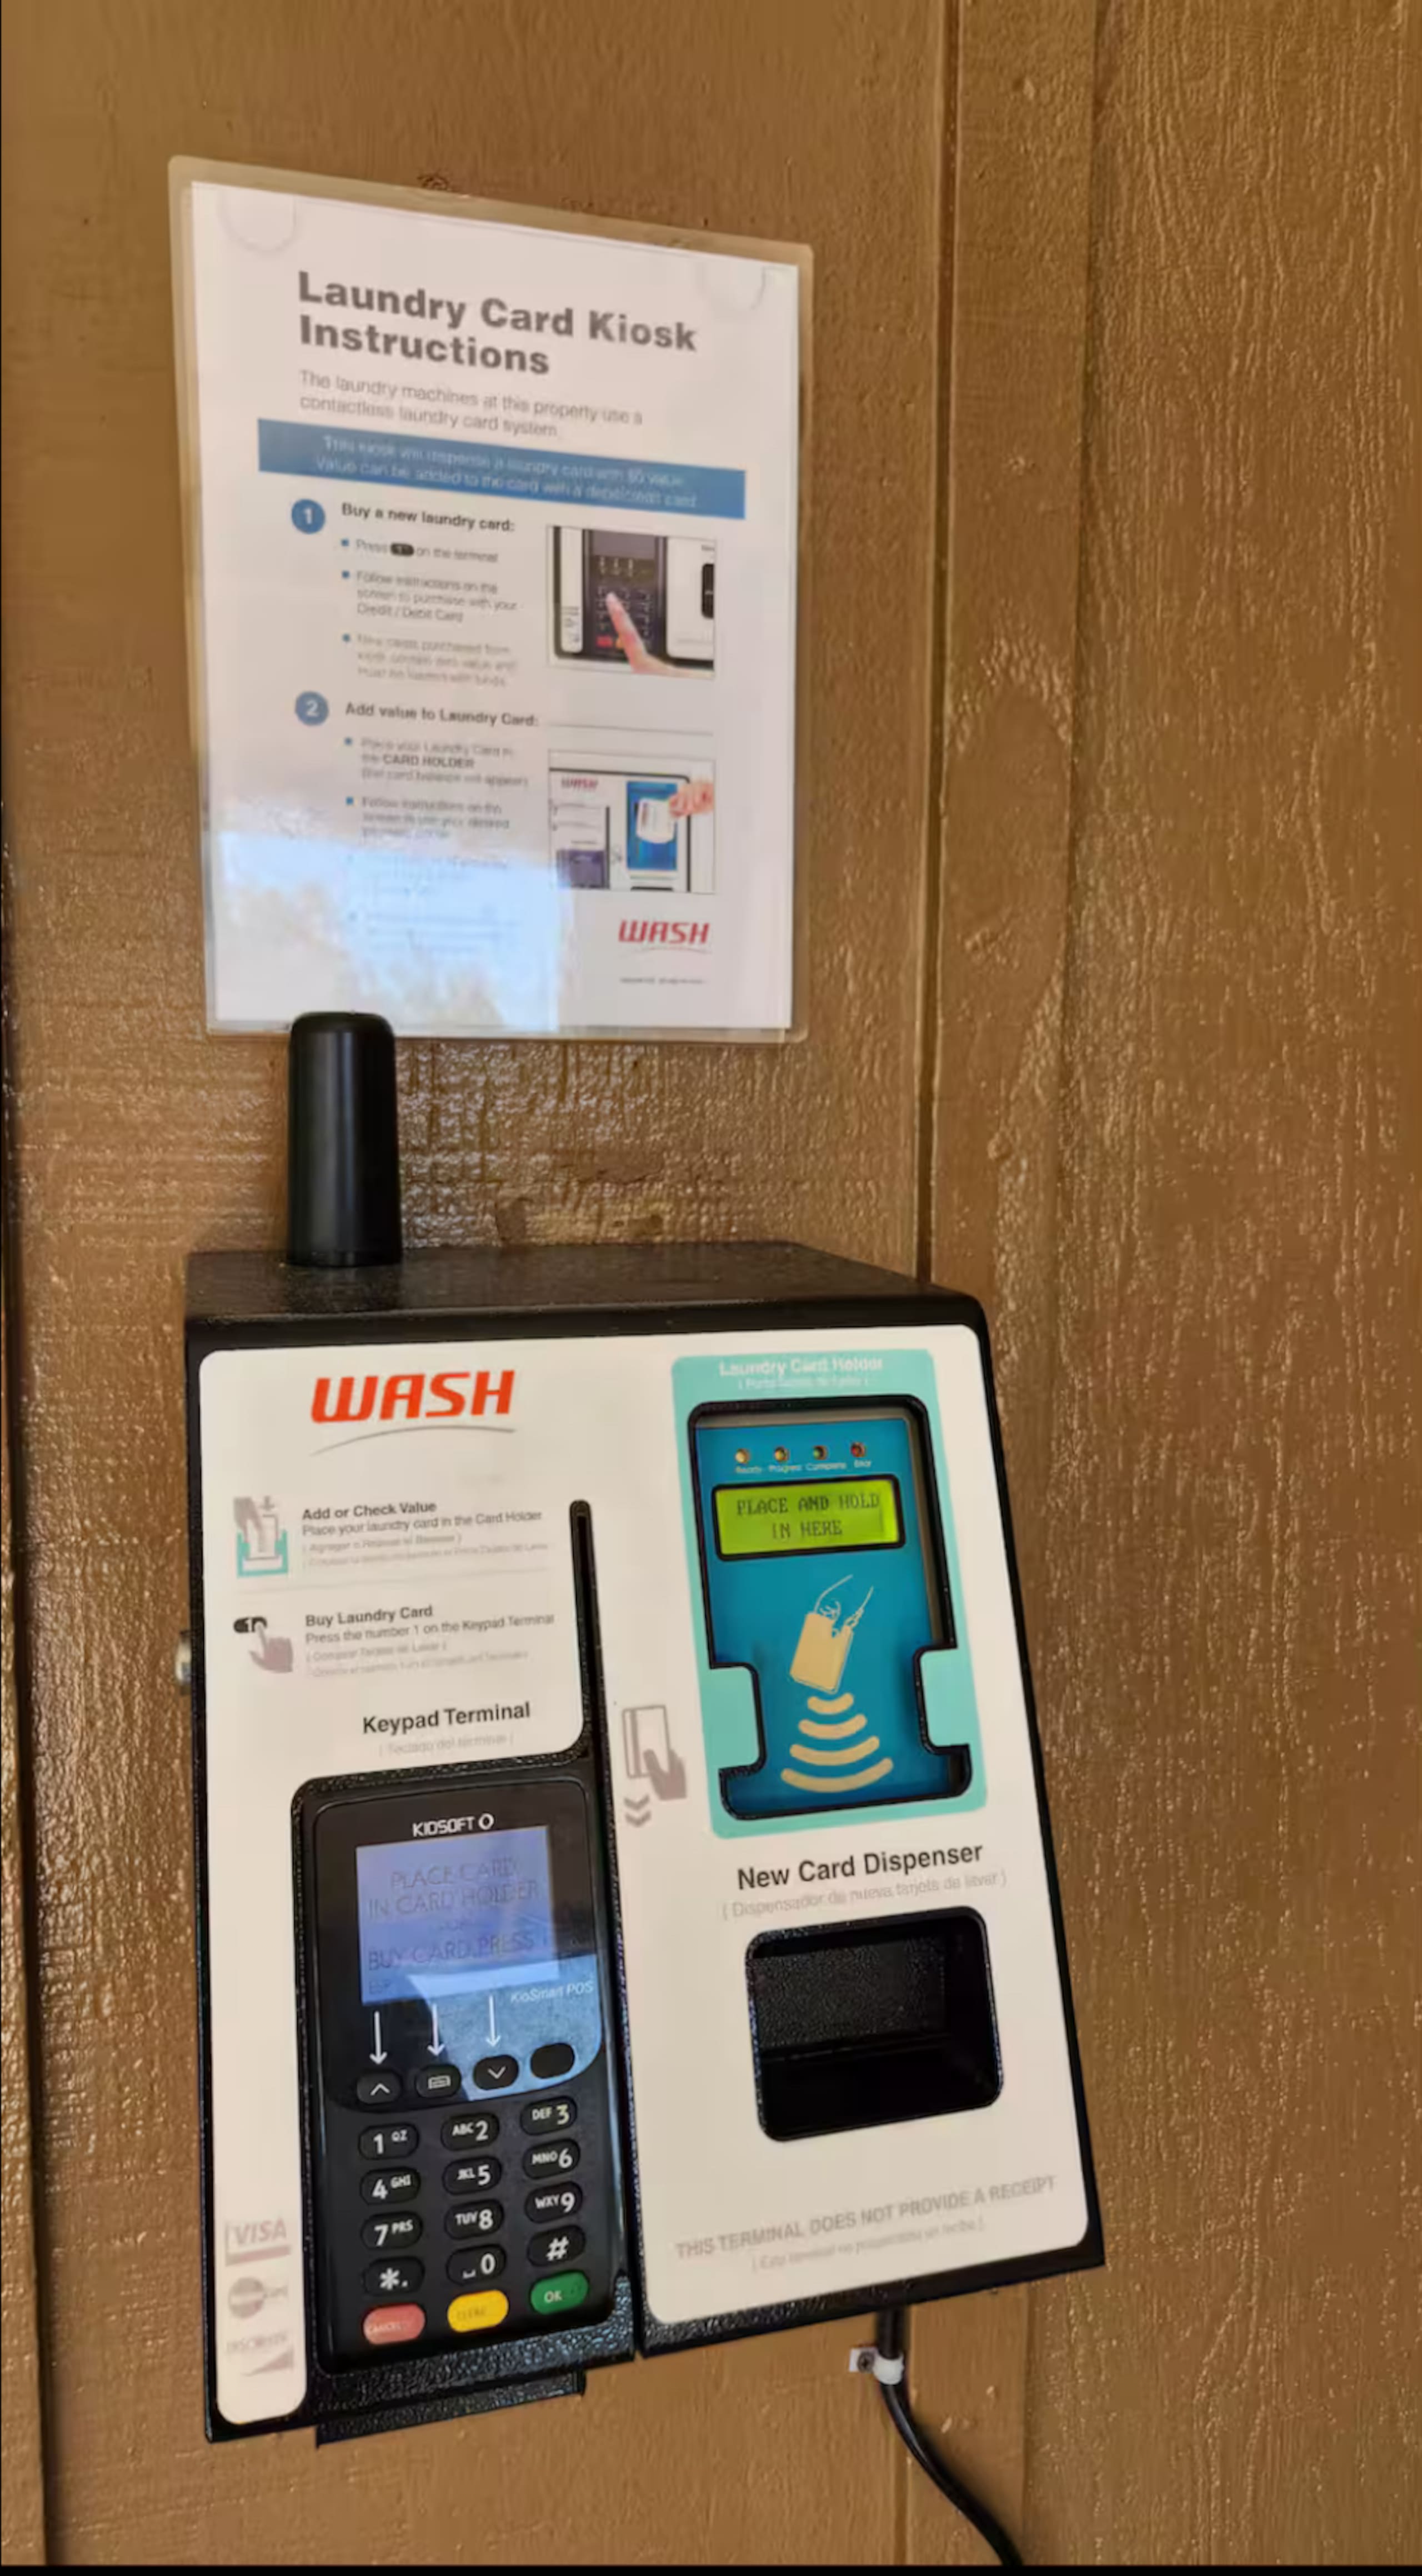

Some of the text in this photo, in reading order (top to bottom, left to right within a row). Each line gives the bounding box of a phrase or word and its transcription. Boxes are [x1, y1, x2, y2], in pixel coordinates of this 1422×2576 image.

[297, 269, 698, 352] Laundry Card Kiosk
[299, 314, 551, 376] Instructions
[299, 369, 643, 426] The laundry machines at this property use a
[299, 394, 394, 419] contactless
[399, 403, 458, 429] laundry
[463, 412, 499, 431] card
[316, 456, 357, 473] Value
[463, 470, 479, 486] to
[303, 507, 314, 525] 1
[341, 502, 515, 533] Buy a new laundry card:
[416, 546, 431, 557] on
[433, 545, 452, 559] the
[454, 548, 499, 563] terminal
[357, 570, 393, 585] Follow
[396, 573, 460, 592] instructions
[463, 581, 479, 593] on
[357, 601, 393, 618] Credit
[403, 605, 433, 621] Debit
[434, 607, 464, 624] Card
[413, 592, 465, 610] purchase
[494, 600, 518, 613] your
[306, 700, 319, 717] 2
[345, 701, 539, 727] Add value to Laundry Card:
[382, 753, 419, 767] CARD
[422, 756, 475, 770] HOLDER
[617, 918, 711, 946] WASH
[719, 1355, 884, 1379] Laundry Card Holder
[310, 1368, 517, 1425] WASH
[302, 1500, 437, 1521] Add or Check Value
[736, 1491, 882, 1516] PLACE AND HOLD
[302, 1510, 543, 1537] Place your laundry card in the Card Holder
[772, 1519, 843, 1539] IN HERE
[305, 1603, 433, 1629] Buy Laundry Card
[306, 1632, 341, 1645] Press
[343, 1629, 363, 1641] the
[365, 1626, 410, 1640] number
[423, 1624, 439, 1635] on
[442, 1622, 460, 1633] the
[463, 1618, 505, 1632] Keypad
[508, 1613, 555, 1627] Terminal
[362, 1699, 532, 1737] Keypad Terminal
[412, 1815, 477, 1838] KIOSOFT
[391, 1864, 454, 1890] PLACE
[736, 1844, 984, 1891] New Card Dispenser
[368, 1897, 390, 1918] IN
[395, 1888, 455, 1915] CARD
[731, 1892, 824, 1919] Dispensador
[368, 1946, 405, 1972] BUY
[411, 1939, 472, 1964] CARD
[566, 1979, 595, 1996] POS
[531, 2104, 570, 2125] DEF 3
[452, 2120, 489, 2141] ABC 2
[373, 2133, 384, 2155] 1
[531, 2148, 573, 2169] MNO 6
[372, 2174, 412, 2200] 4 GHI
[477, 2164, 491, 2186] 5
[534, 2191, 576, 2213] WXY 9
[454, 2209, 493, 2231] TUV 8
[675, 2174, 1056, 2260] THIS TERMINAL DOES NOT PROVIDE A RECEIPT
[233, 2216, 287, 2245] VISA
[374, 2219, 413, 2247] 7 PRS
[479, 2253, 496, 2275] 0
[543, 2290, 563, 2304] OK
